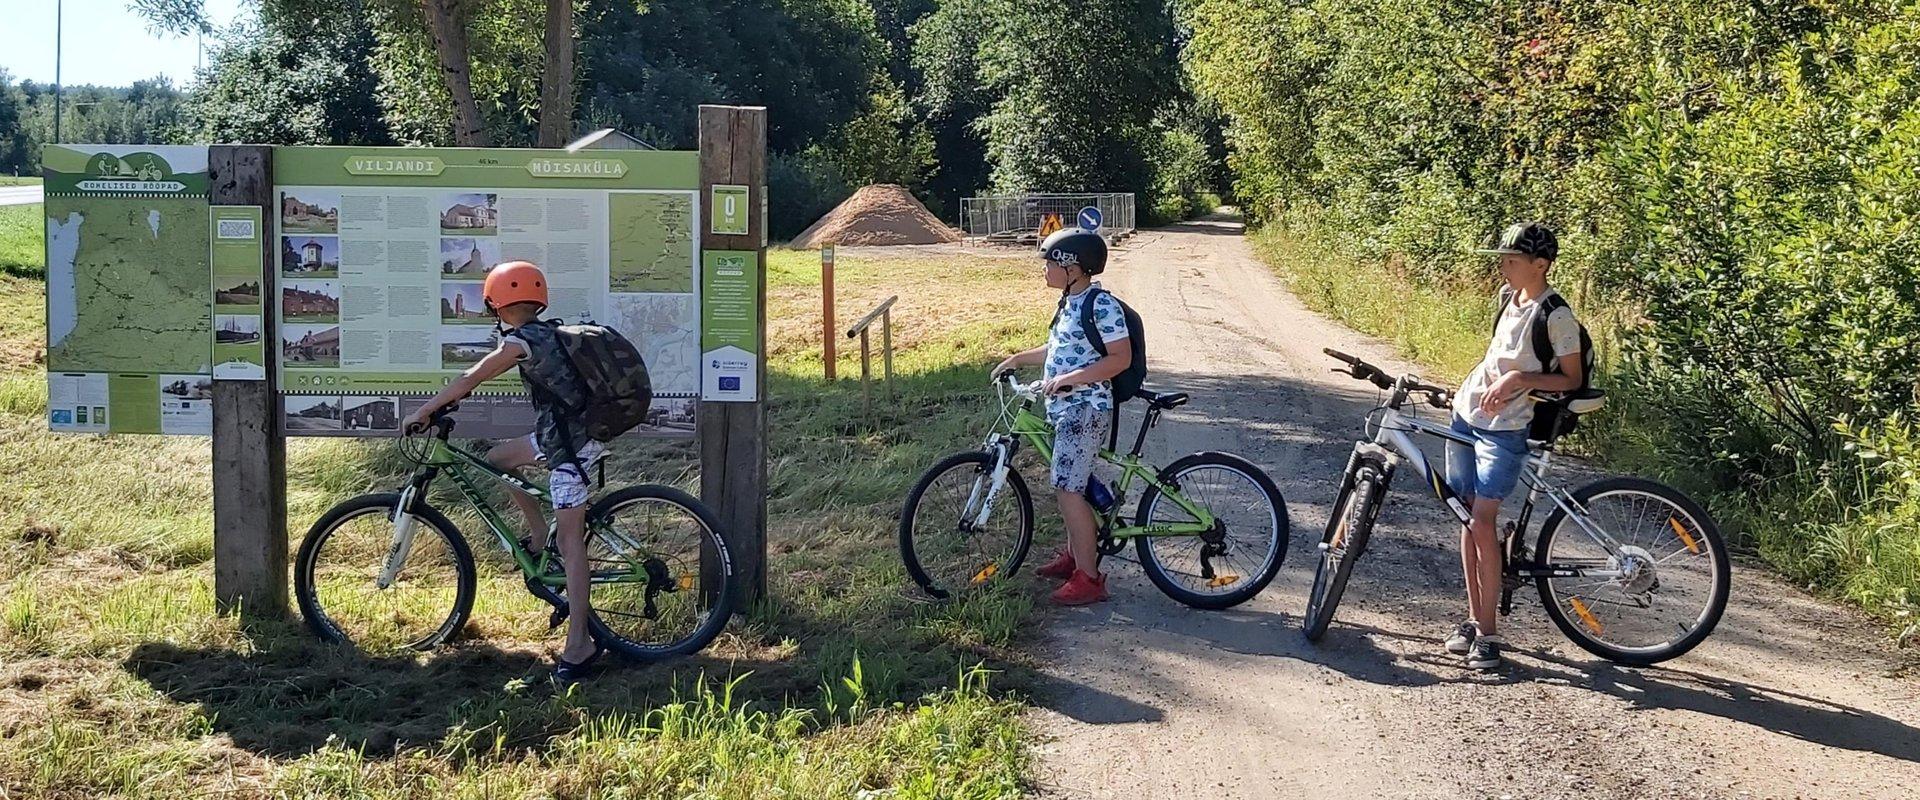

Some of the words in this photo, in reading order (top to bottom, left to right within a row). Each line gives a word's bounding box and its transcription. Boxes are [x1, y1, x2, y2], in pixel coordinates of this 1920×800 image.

[355, 160, 434, 172] VILJANDI
[532, 160, 622, 174] MÕISAKÜLA
[84, 182, 137, 190] ROHELISED
[725, 195, 735, 217] 0
[1142, 524, 1173, 534] CLASSIC
